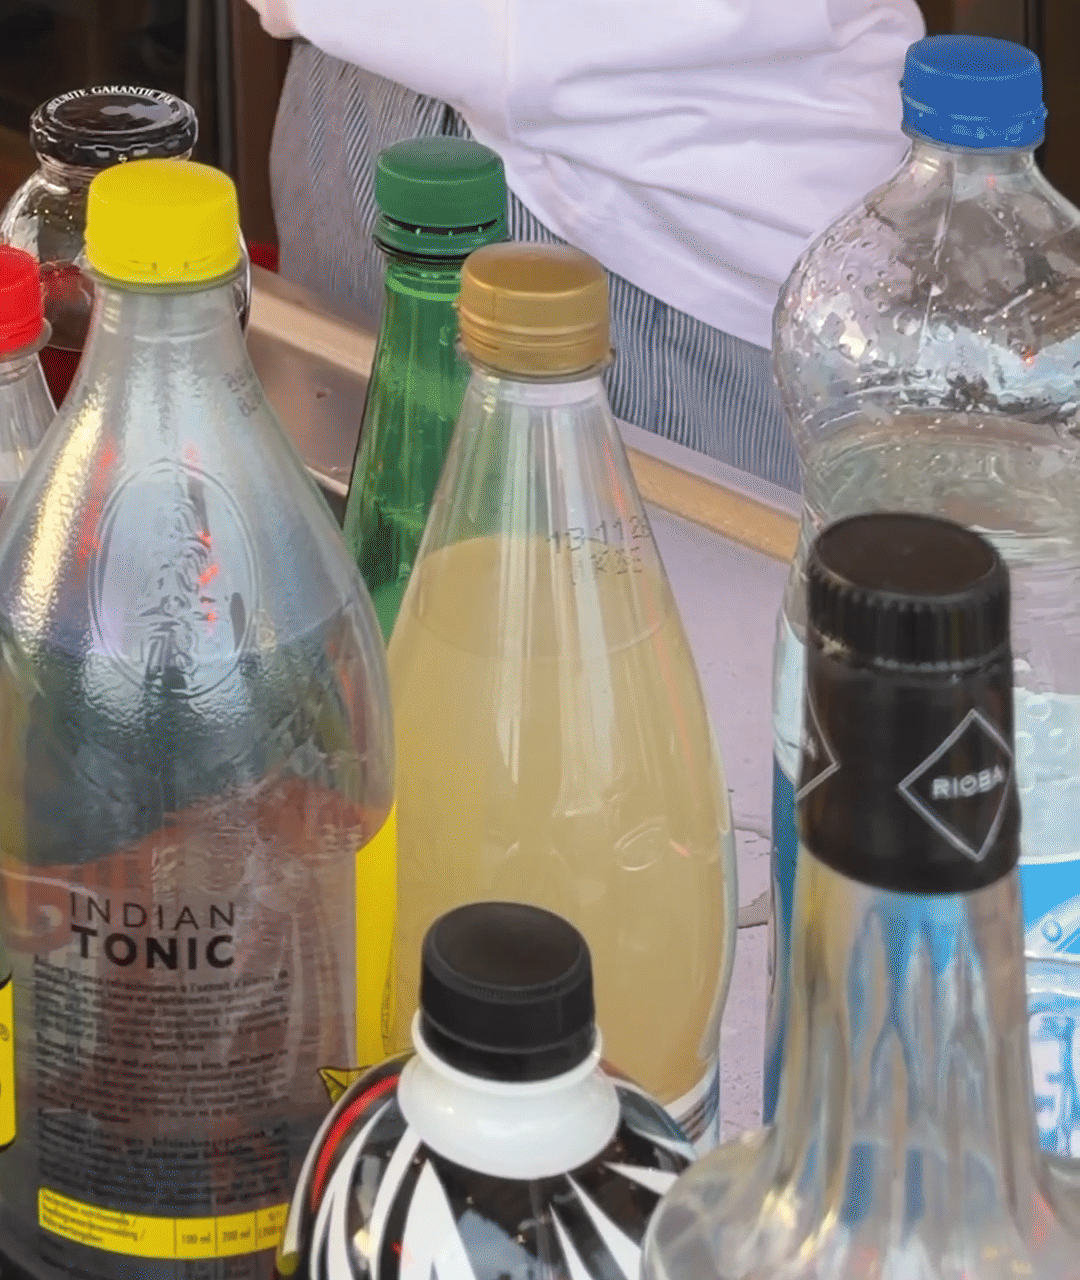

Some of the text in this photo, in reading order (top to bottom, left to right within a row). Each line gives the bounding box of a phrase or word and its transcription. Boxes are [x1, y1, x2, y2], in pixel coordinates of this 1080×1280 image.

[931, 765, 1005, 800] RIOBA
[69, 891, 236, 931] INDIAN
[70, 923, 236, 971] TONIC
